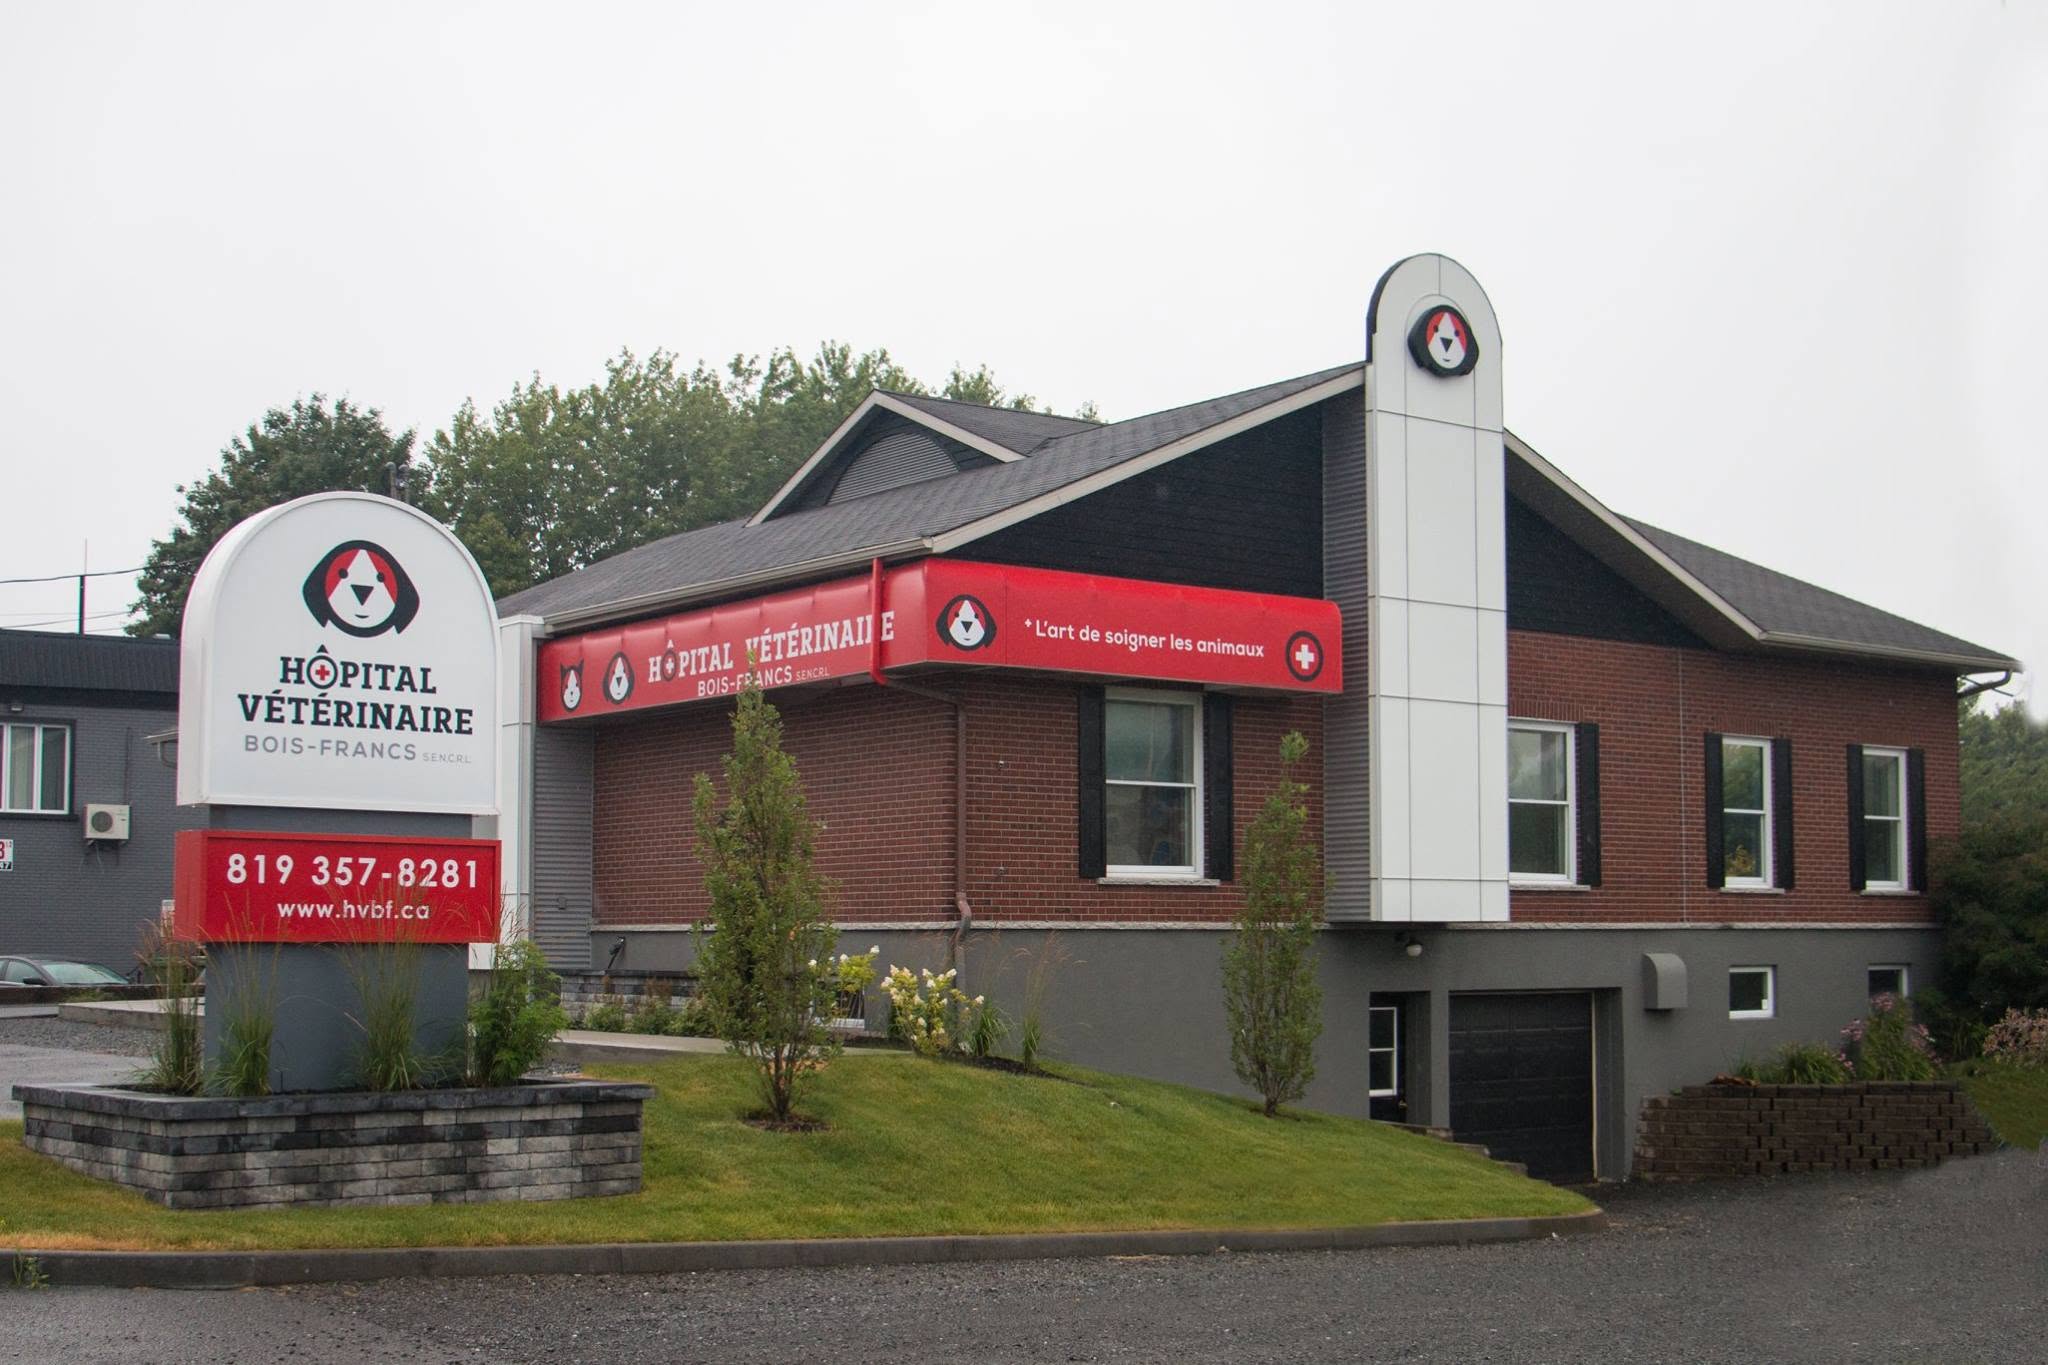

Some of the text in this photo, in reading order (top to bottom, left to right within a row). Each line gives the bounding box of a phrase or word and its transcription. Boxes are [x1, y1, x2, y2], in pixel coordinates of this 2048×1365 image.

[1036, 619, 1264, 657] L'art de soigner les animaux
[279, 644, 437, 694] HÔPITAL
[647, 639, 734, 683] HÔPITAL
[237, 689, 473, 735] VÉTÉRINAIRE
[244, 735, 417, 760] BOIS-FRANCS
[226, 853, 477, 888] 819 357-8281
[277, 900, 430, 919] www.hvbf.ca
